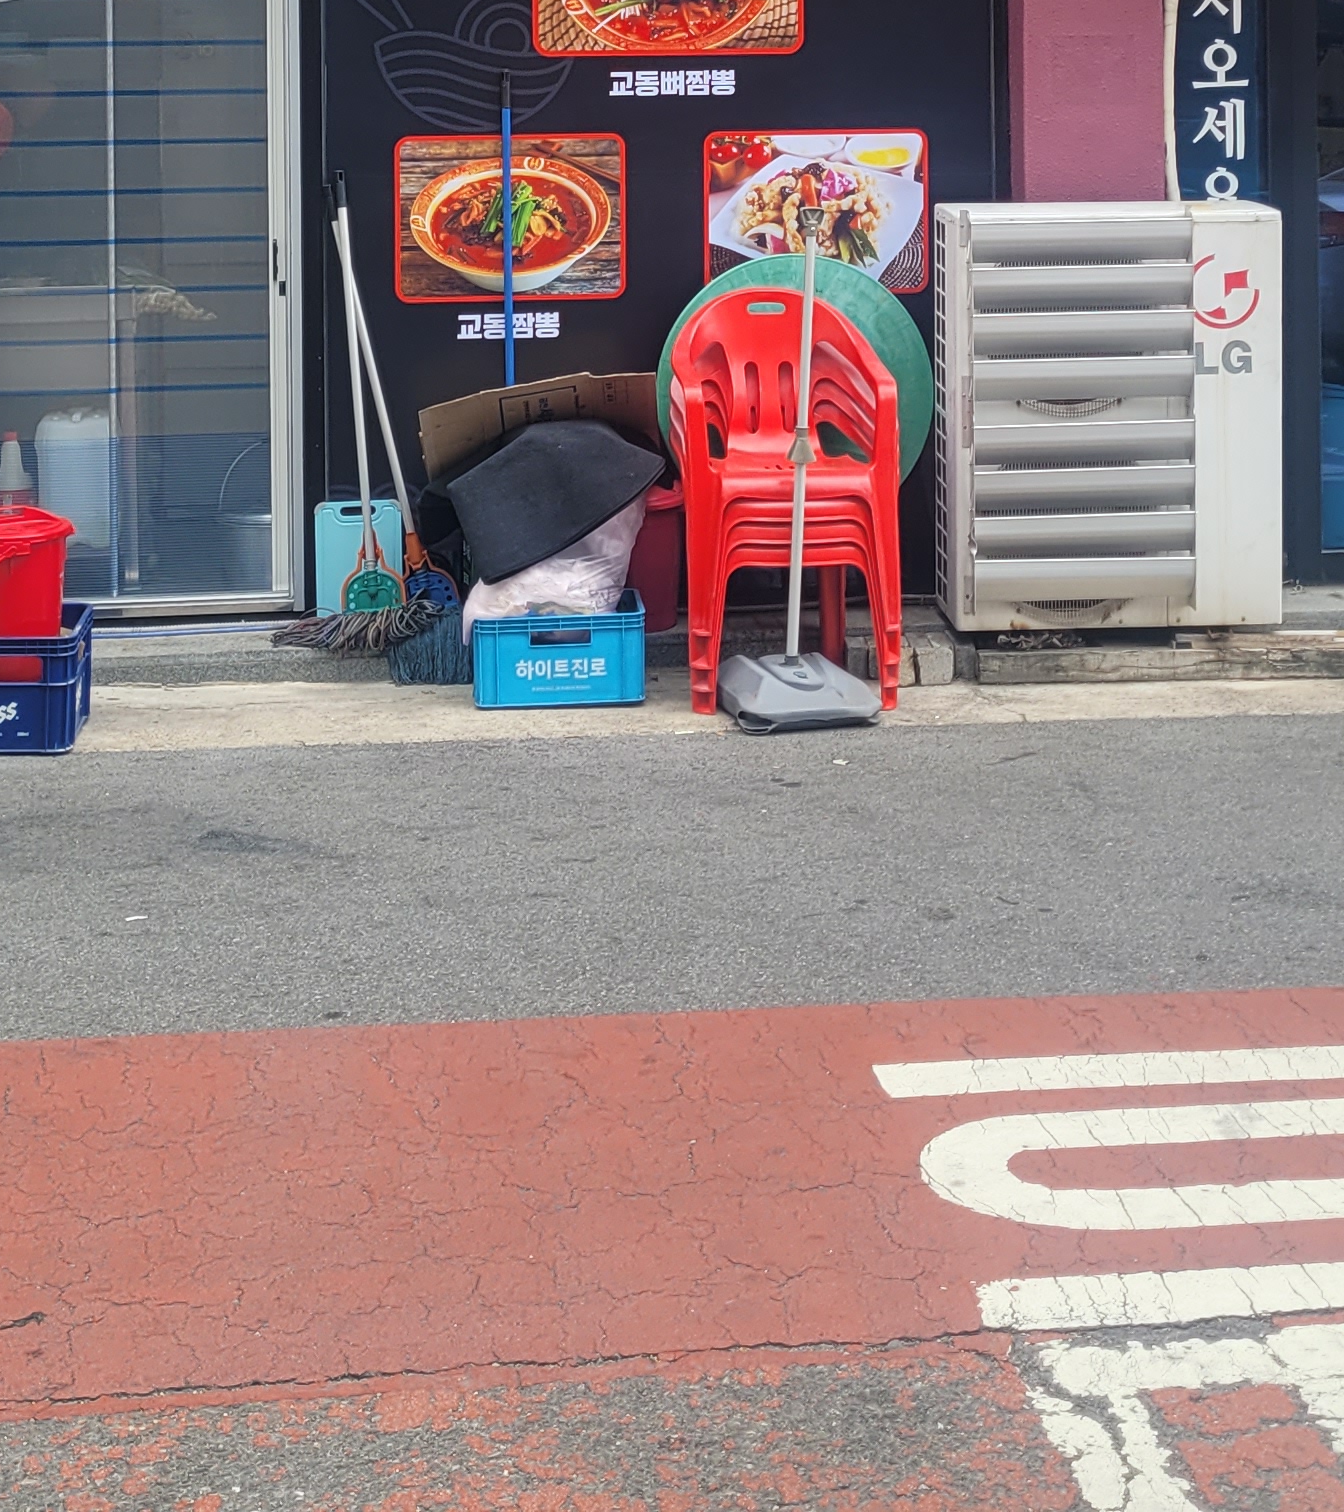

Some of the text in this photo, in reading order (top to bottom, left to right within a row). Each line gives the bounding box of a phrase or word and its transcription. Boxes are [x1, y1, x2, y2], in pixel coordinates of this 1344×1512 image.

[608, 69, 736, 98] 교동뼈짬뽕
[457, 311, 561, 340] 교동짬뽕
[1195, 340, 1252, 375] LG
[515, 657, 608, 681] 하이트진로
